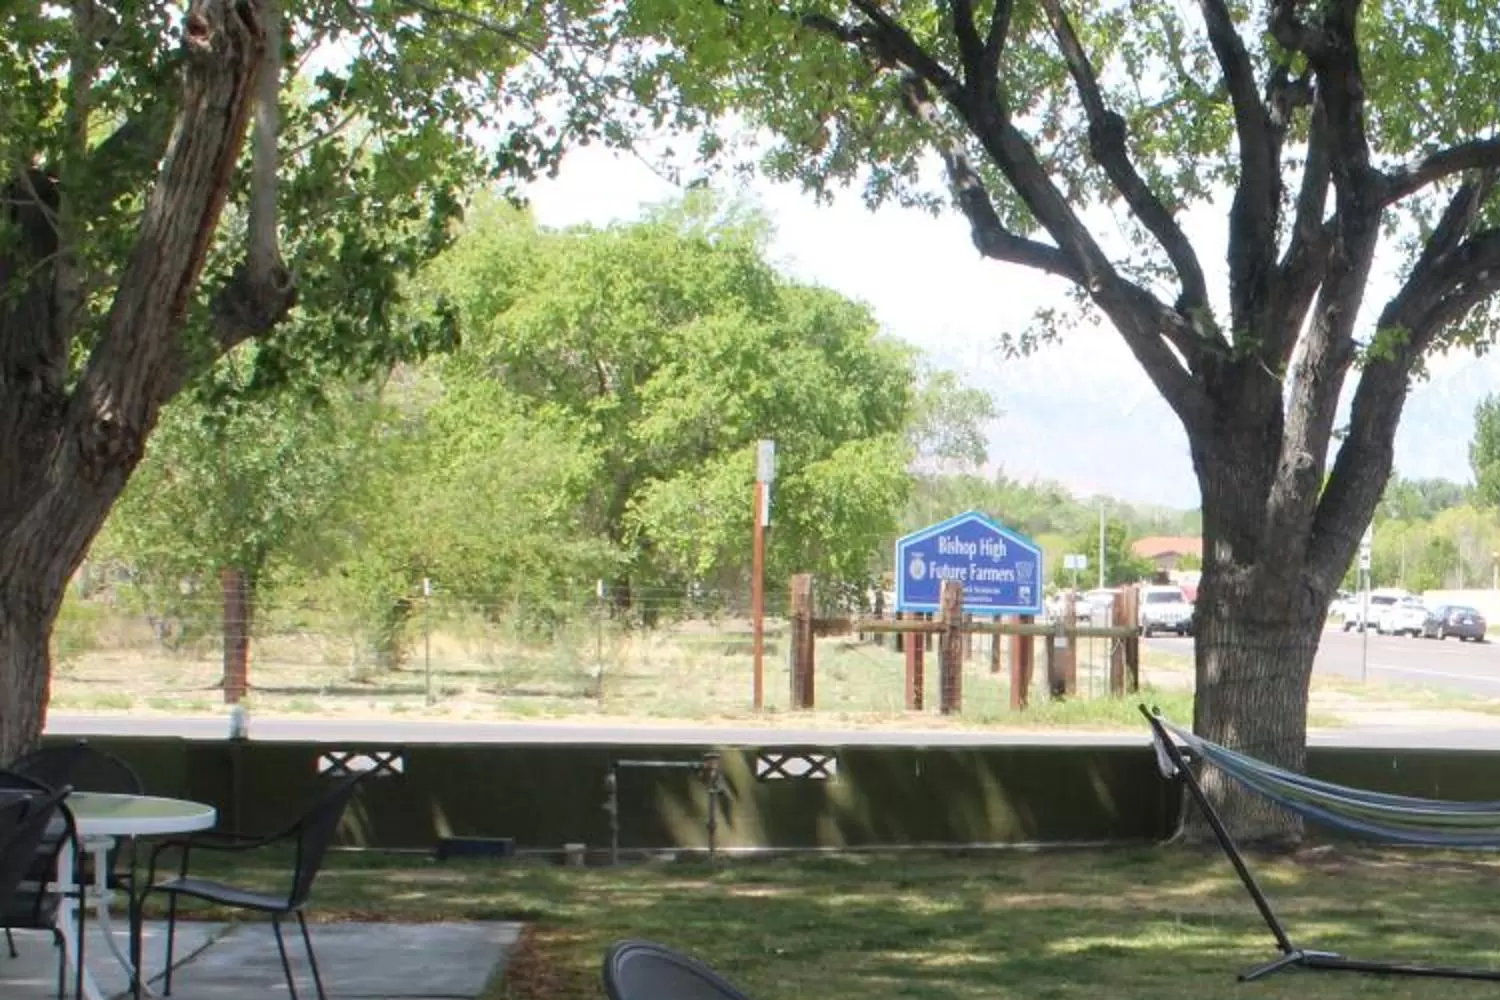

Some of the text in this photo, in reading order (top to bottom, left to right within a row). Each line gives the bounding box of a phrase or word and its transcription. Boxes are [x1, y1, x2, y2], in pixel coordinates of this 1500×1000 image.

[938, 535, 1007, 562] Bishop High
[929, 561, 1015, 582] Future Farmers
